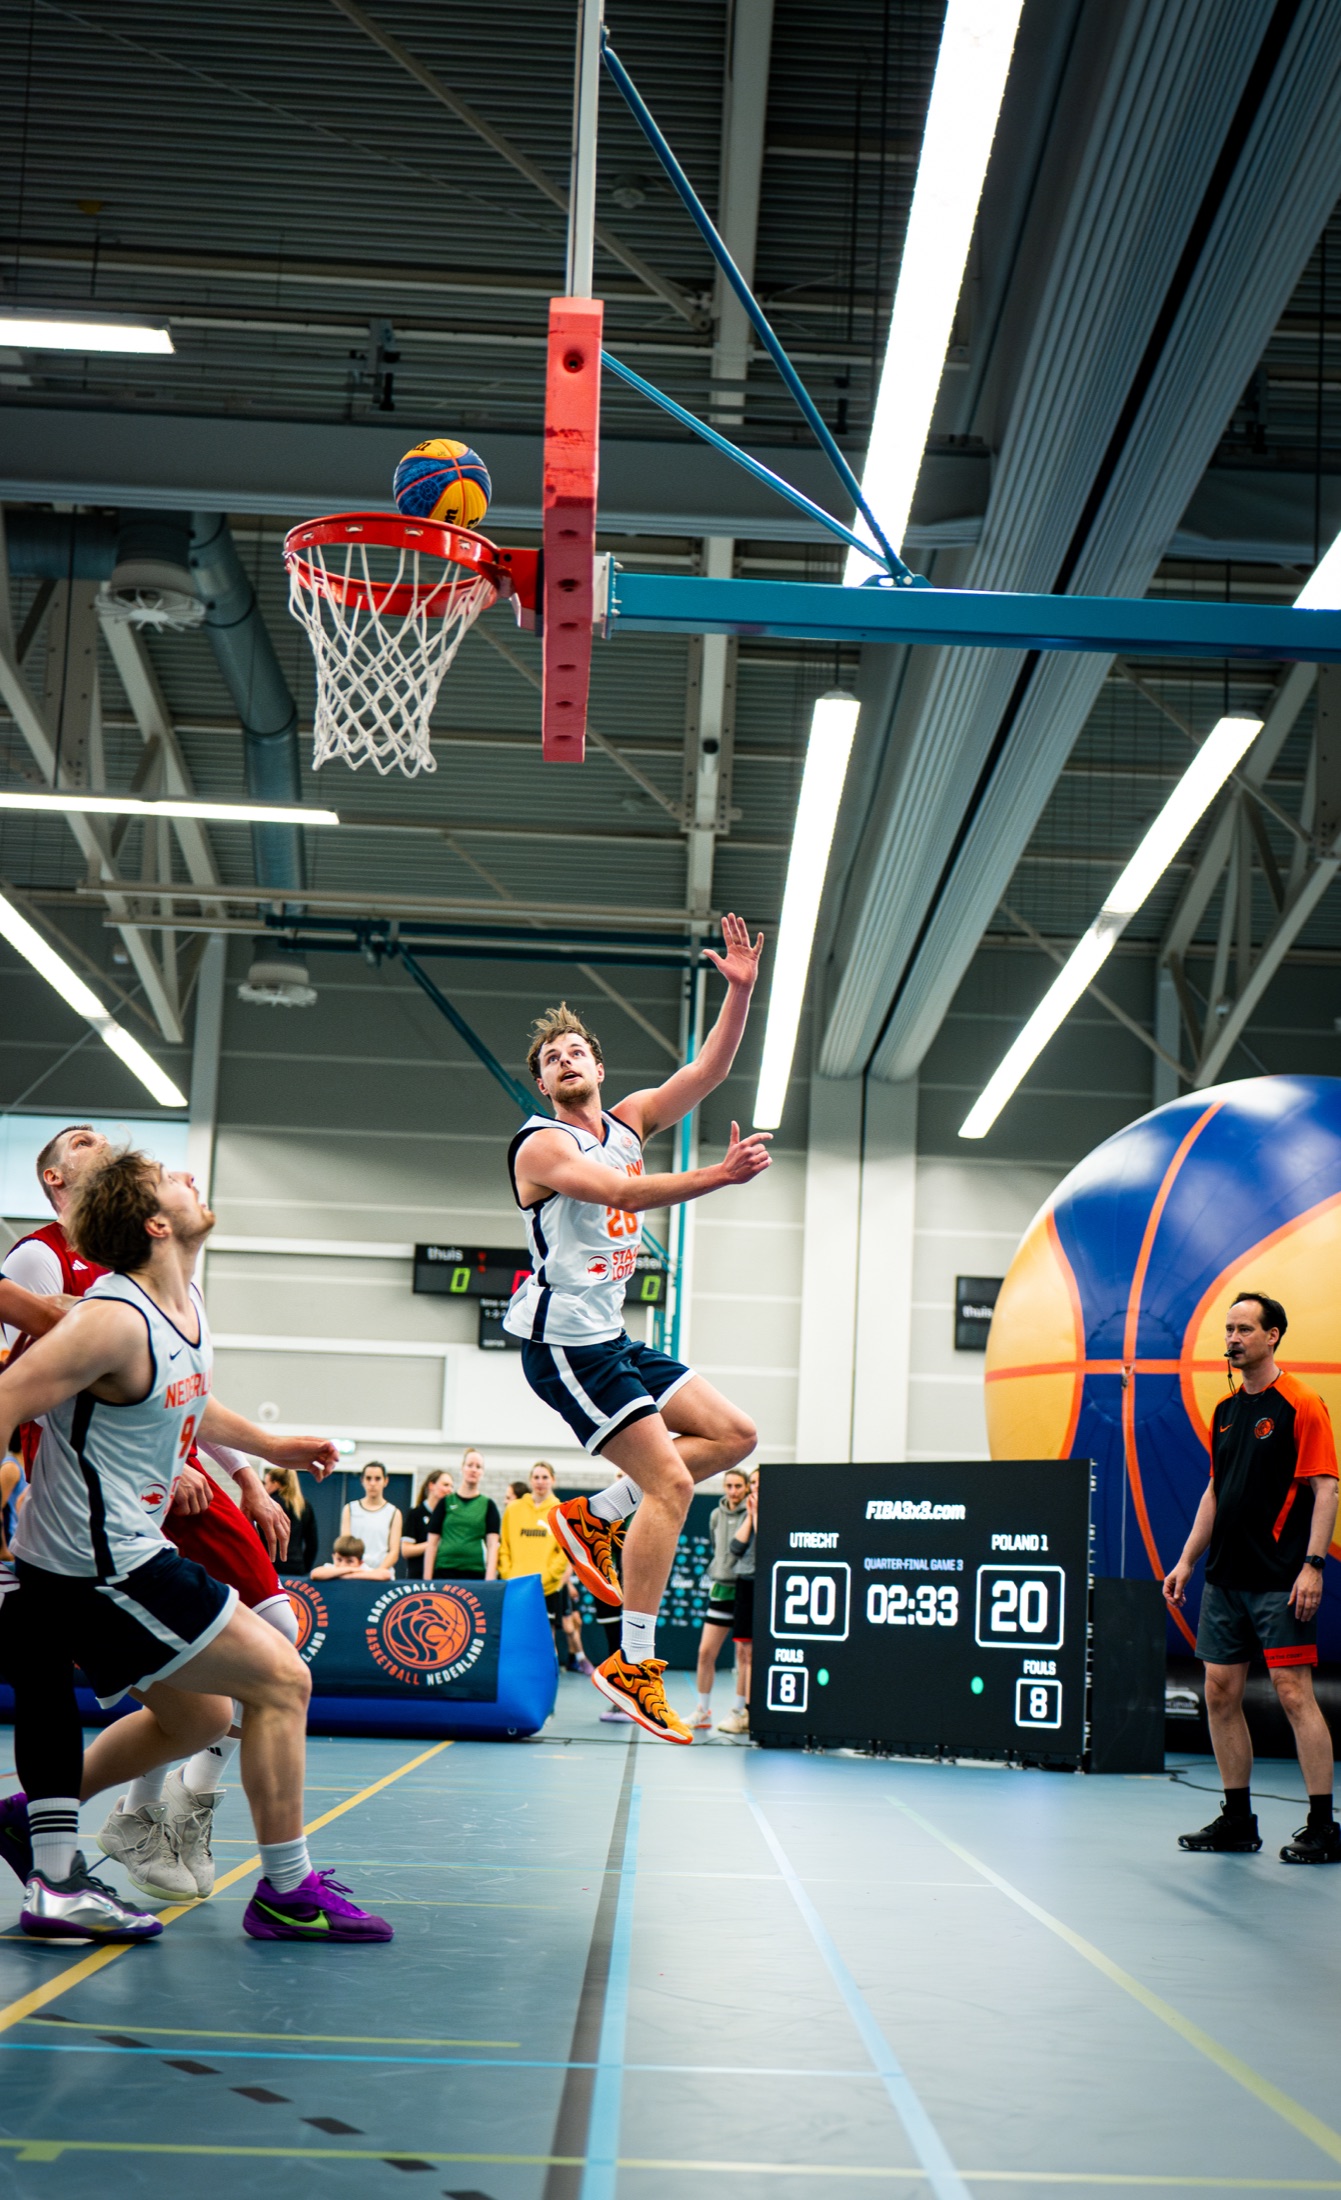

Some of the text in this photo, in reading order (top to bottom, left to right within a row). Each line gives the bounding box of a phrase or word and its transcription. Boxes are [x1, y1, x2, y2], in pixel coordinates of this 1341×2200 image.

[427, 1246, 464, 1262] thuis
[449, 1267, 471, 1293] 0
[641, 1275, 661, 1301] 0
[178, 1413, 196, 1459] 9
[865, 1500, 966, 1520] FIBA3x3.com
[789, 1532, 839, 1549] UTRECHT
[991, 1534, 1049, 1551] POLAND 1
[864, 1557, 964, 1571] QUARTER-FINAL GAME 3
[367, 1583, 487, 1634] BASKETBALL NEDERLAND
[784, 1575, 836, 1625] 20
[866, 1583, 959, 1627] 02:33
[990, 1580, 1048, 1633] 20
[365, 1628, 485, 1686] BASKETBALL NEDERLAND
[775, 1647, 804, 1664] FOULS
[1023, 1659, 1056, 1676] FOULS
[779, 1673, 796, 1703] 8
[1029, 1687, 1048, 1719] 8
